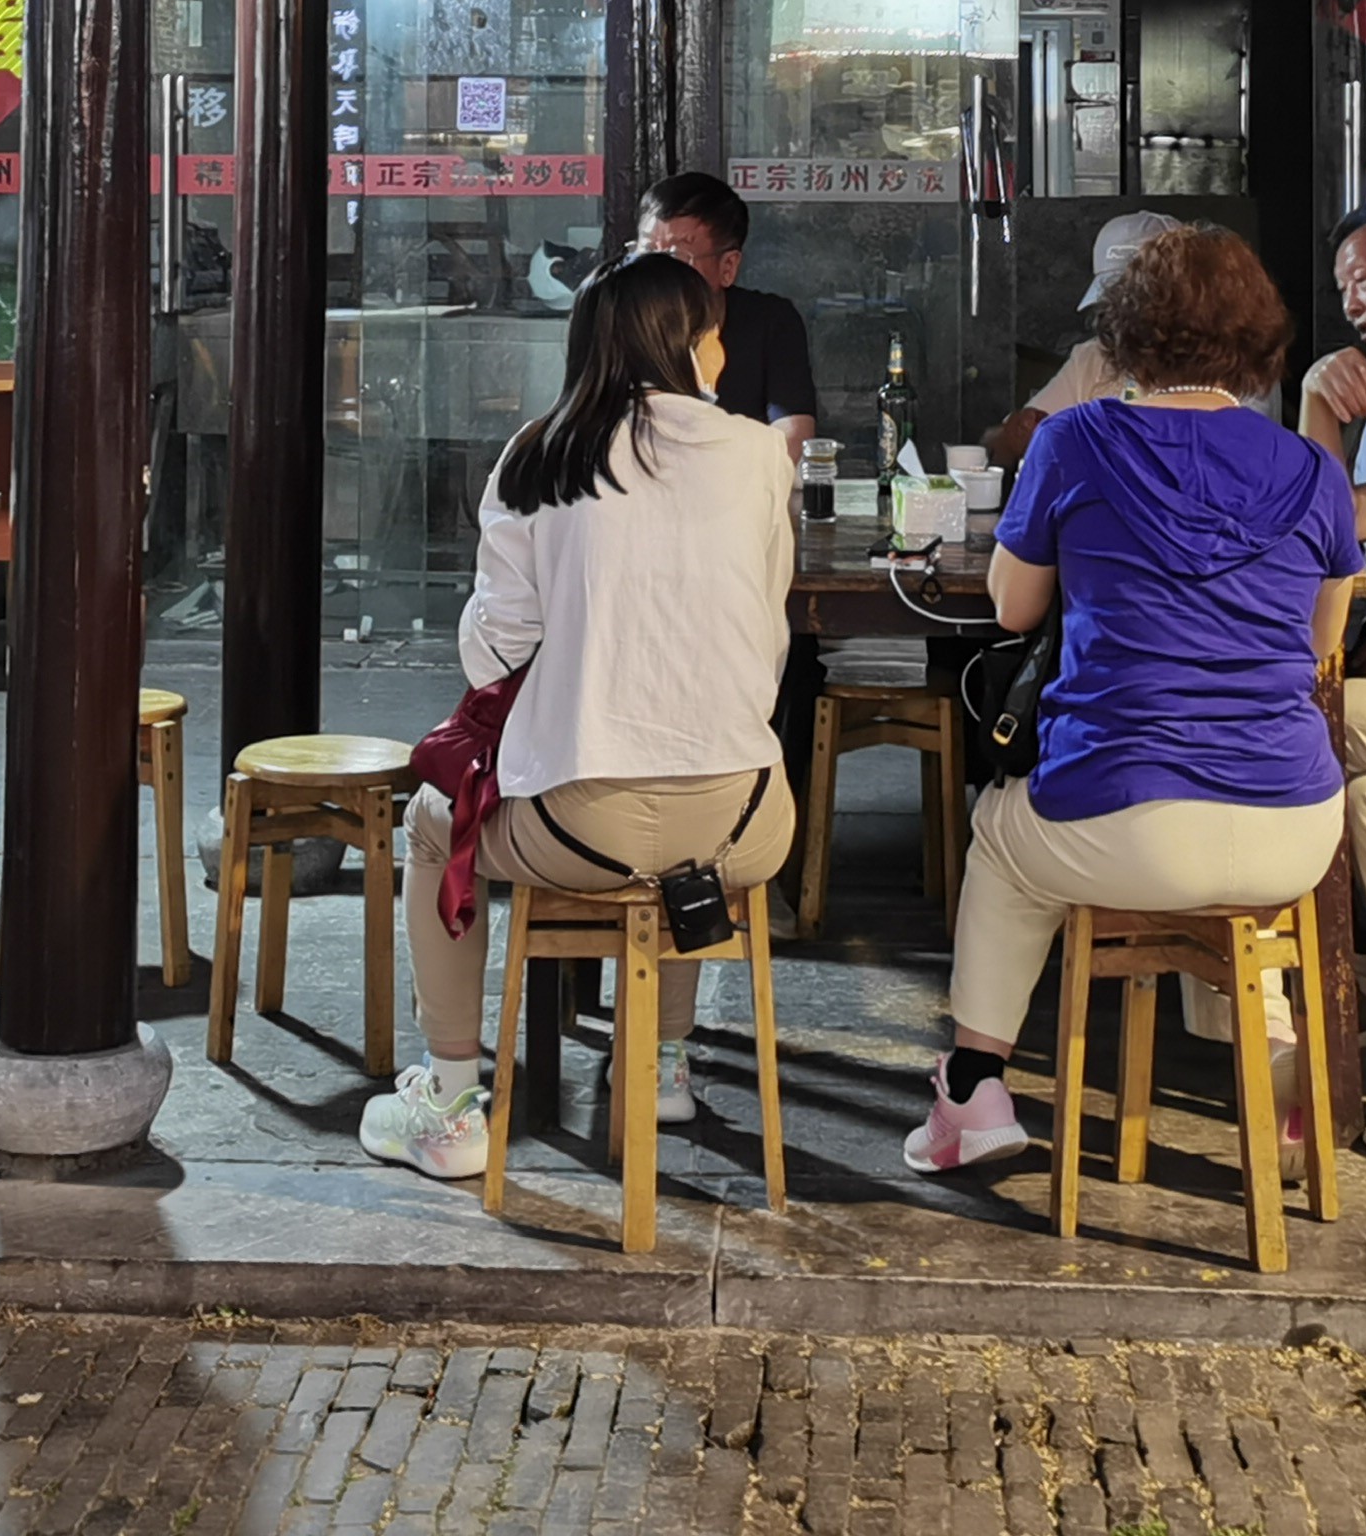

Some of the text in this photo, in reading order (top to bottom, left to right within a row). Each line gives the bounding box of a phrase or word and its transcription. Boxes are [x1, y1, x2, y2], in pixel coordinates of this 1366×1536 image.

[187, 86, 228, 128] 移
[377, 161, 590, 189] 正宗扬州炒饭
[731, 165, 946, 193] 正宗扬州炒饭
